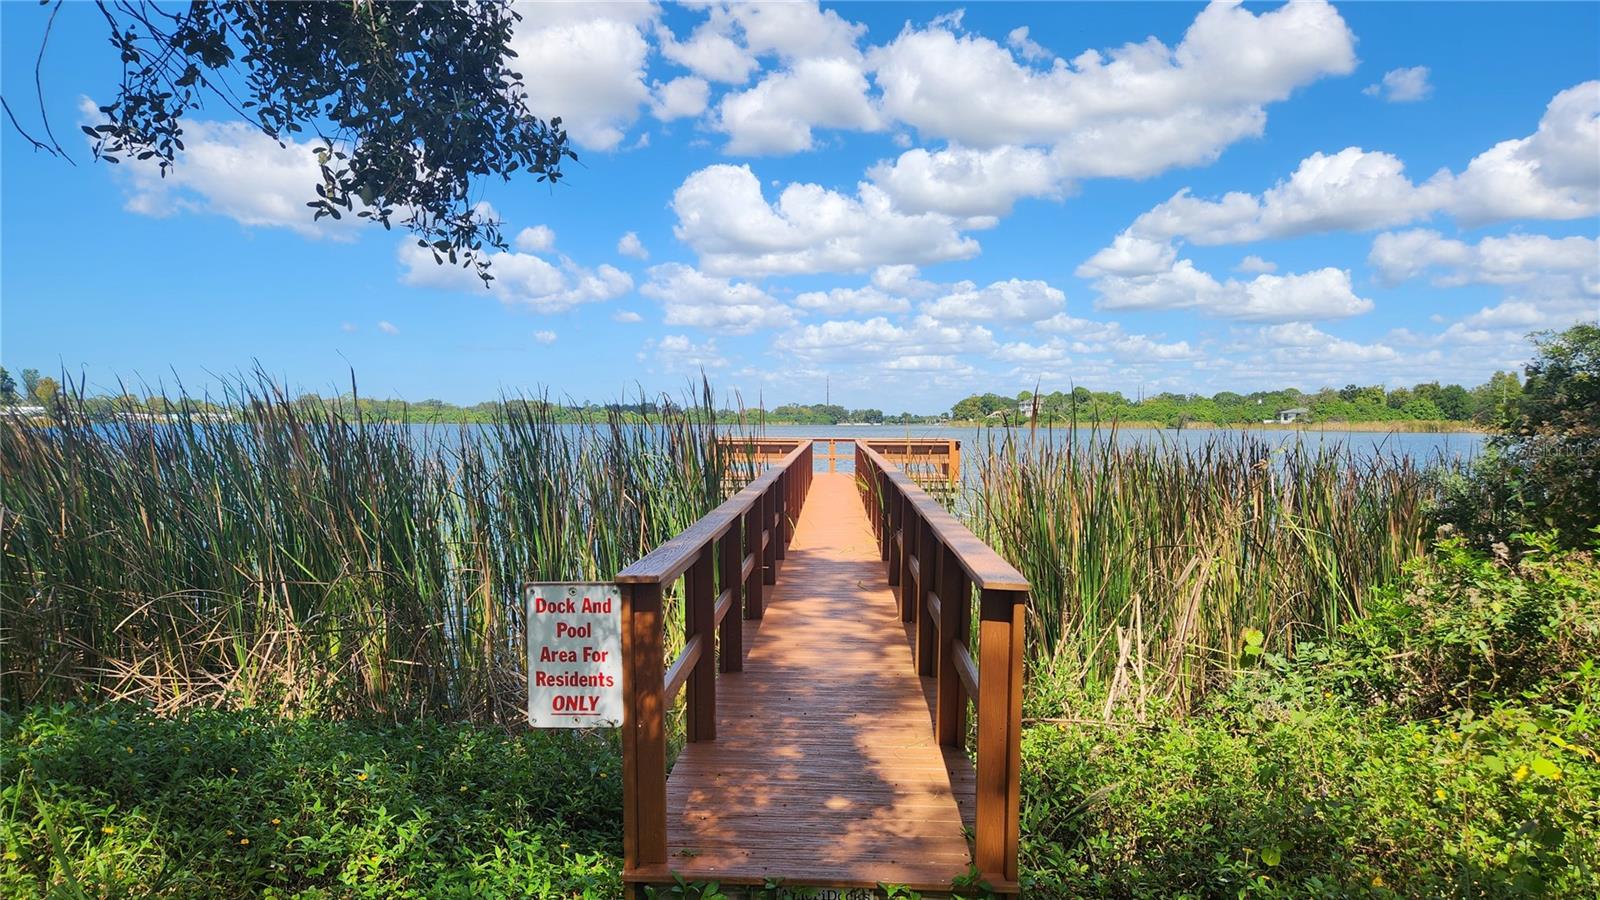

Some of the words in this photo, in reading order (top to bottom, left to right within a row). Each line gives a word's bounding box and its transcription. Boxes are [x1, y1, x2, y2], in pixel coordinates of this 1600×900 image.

[535, 597, 576, 614] Dock
[582, 597, 612, 614] And
[556, 622, 592, 638] Pool
[540, 646, 577, 662] Area
[583, 646, 609, 662] For
[535, 671, 614, 688] Residents
[552, 695, 600, 712] ONLY
